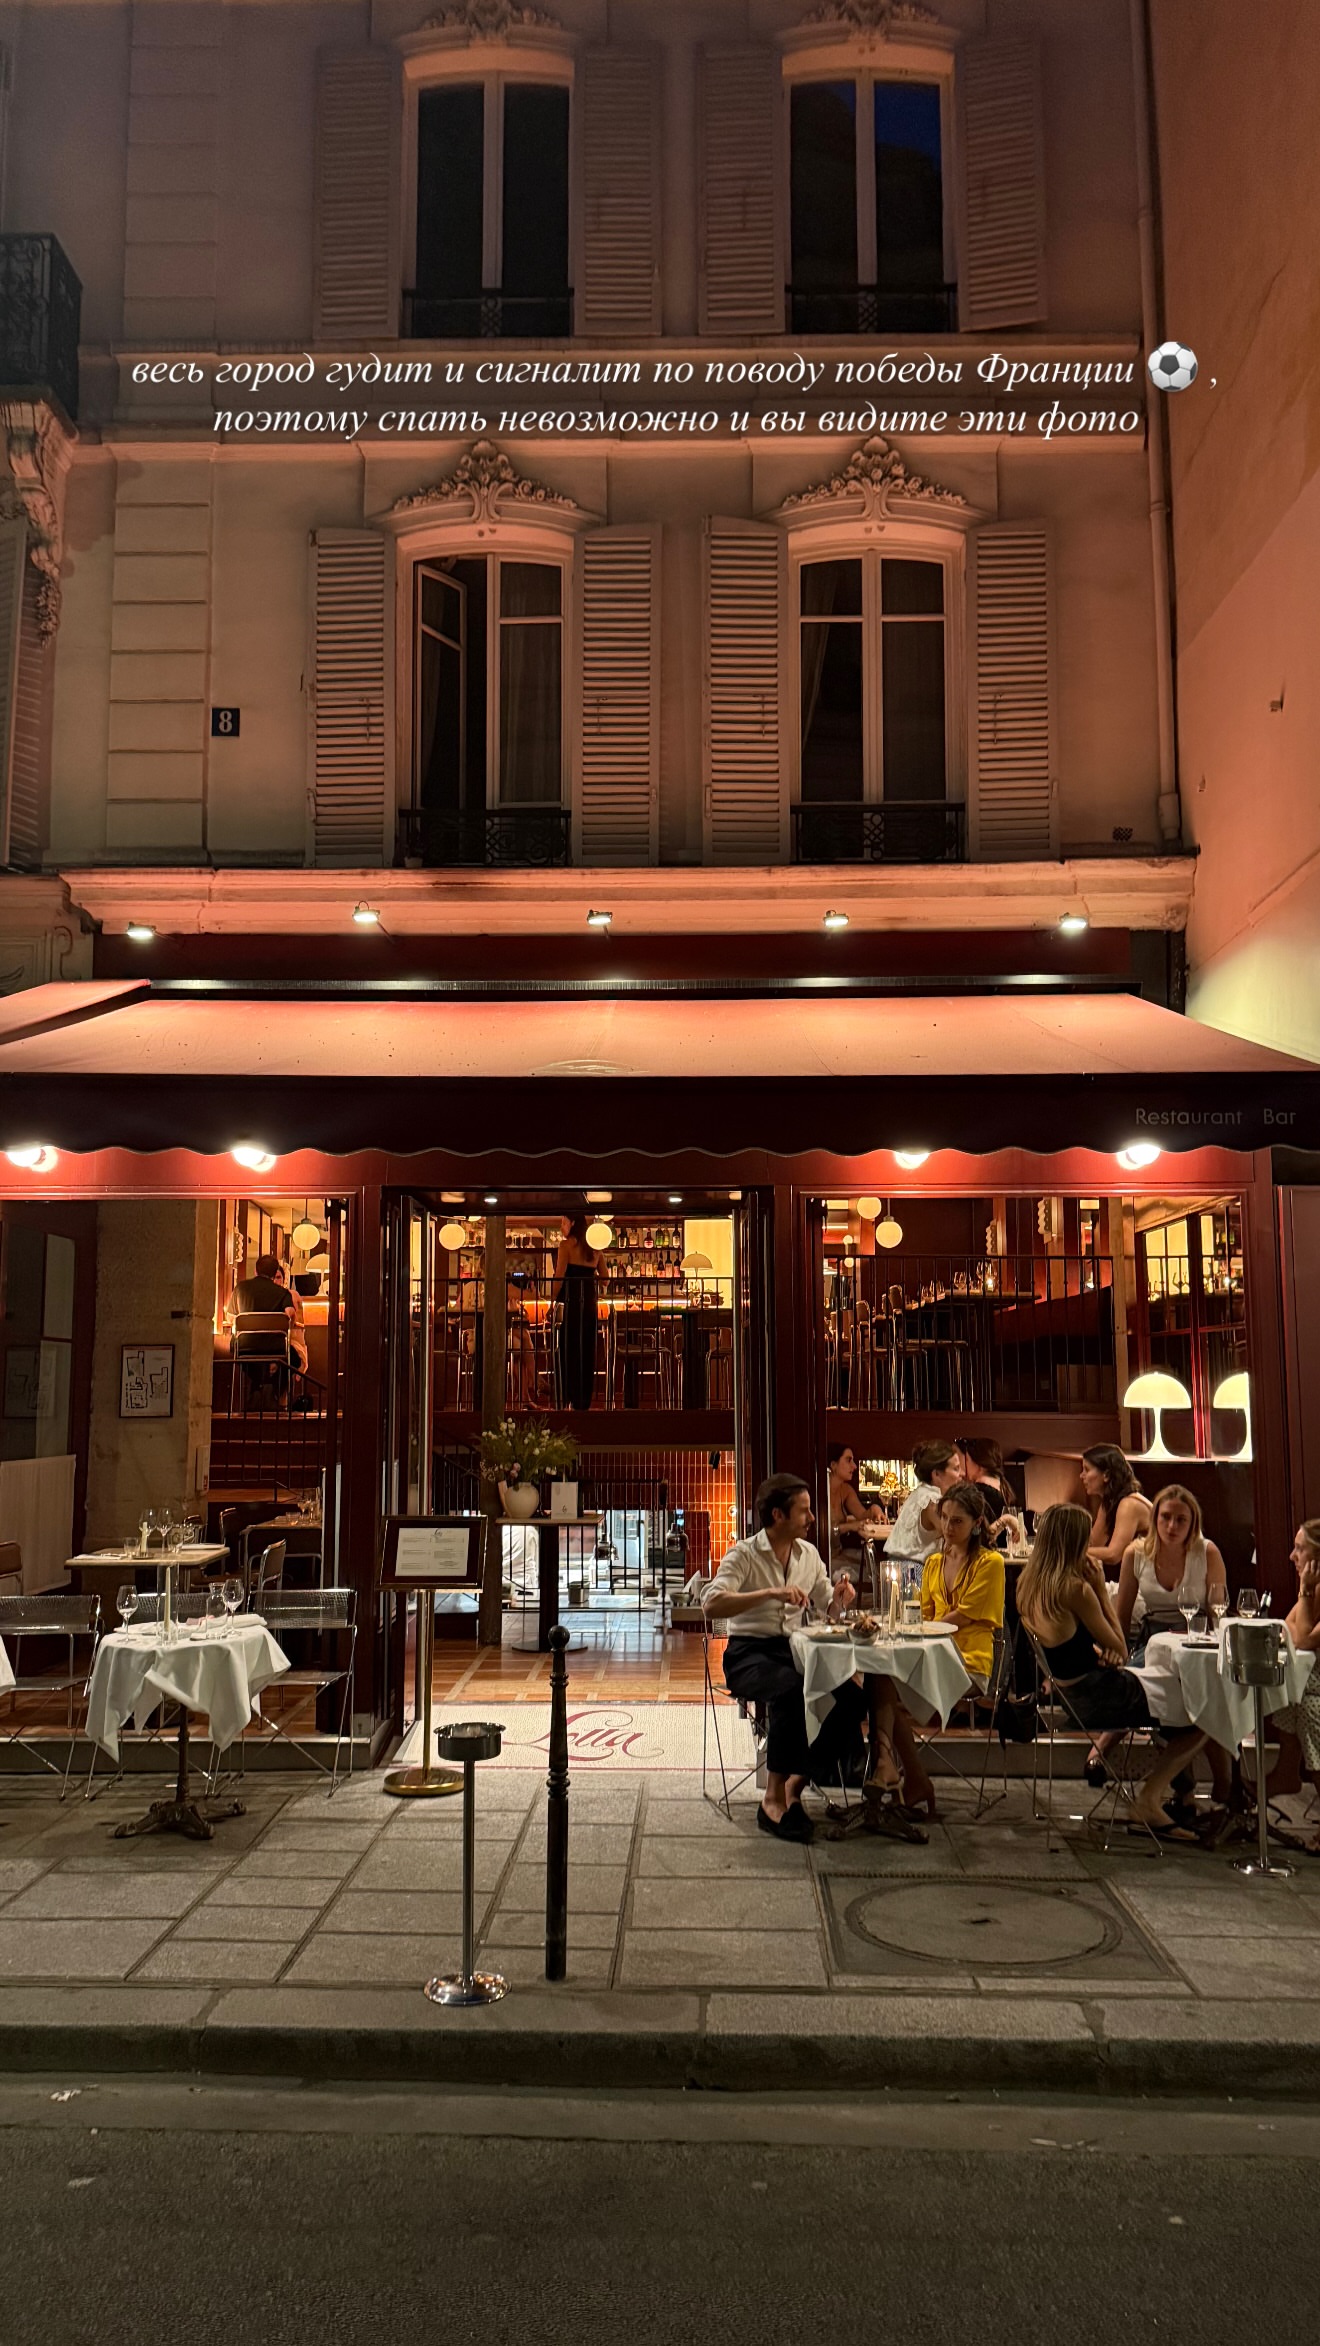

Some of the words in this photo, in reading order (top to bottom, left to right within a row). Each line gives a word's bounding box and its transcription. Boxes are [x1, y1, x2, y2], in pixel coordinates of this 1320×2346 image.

[218, 710, 233, 733] 8
[1135, 1107, 1244, 1126] Restaurant
[1263, 1107, 1297, 1126] Bar
